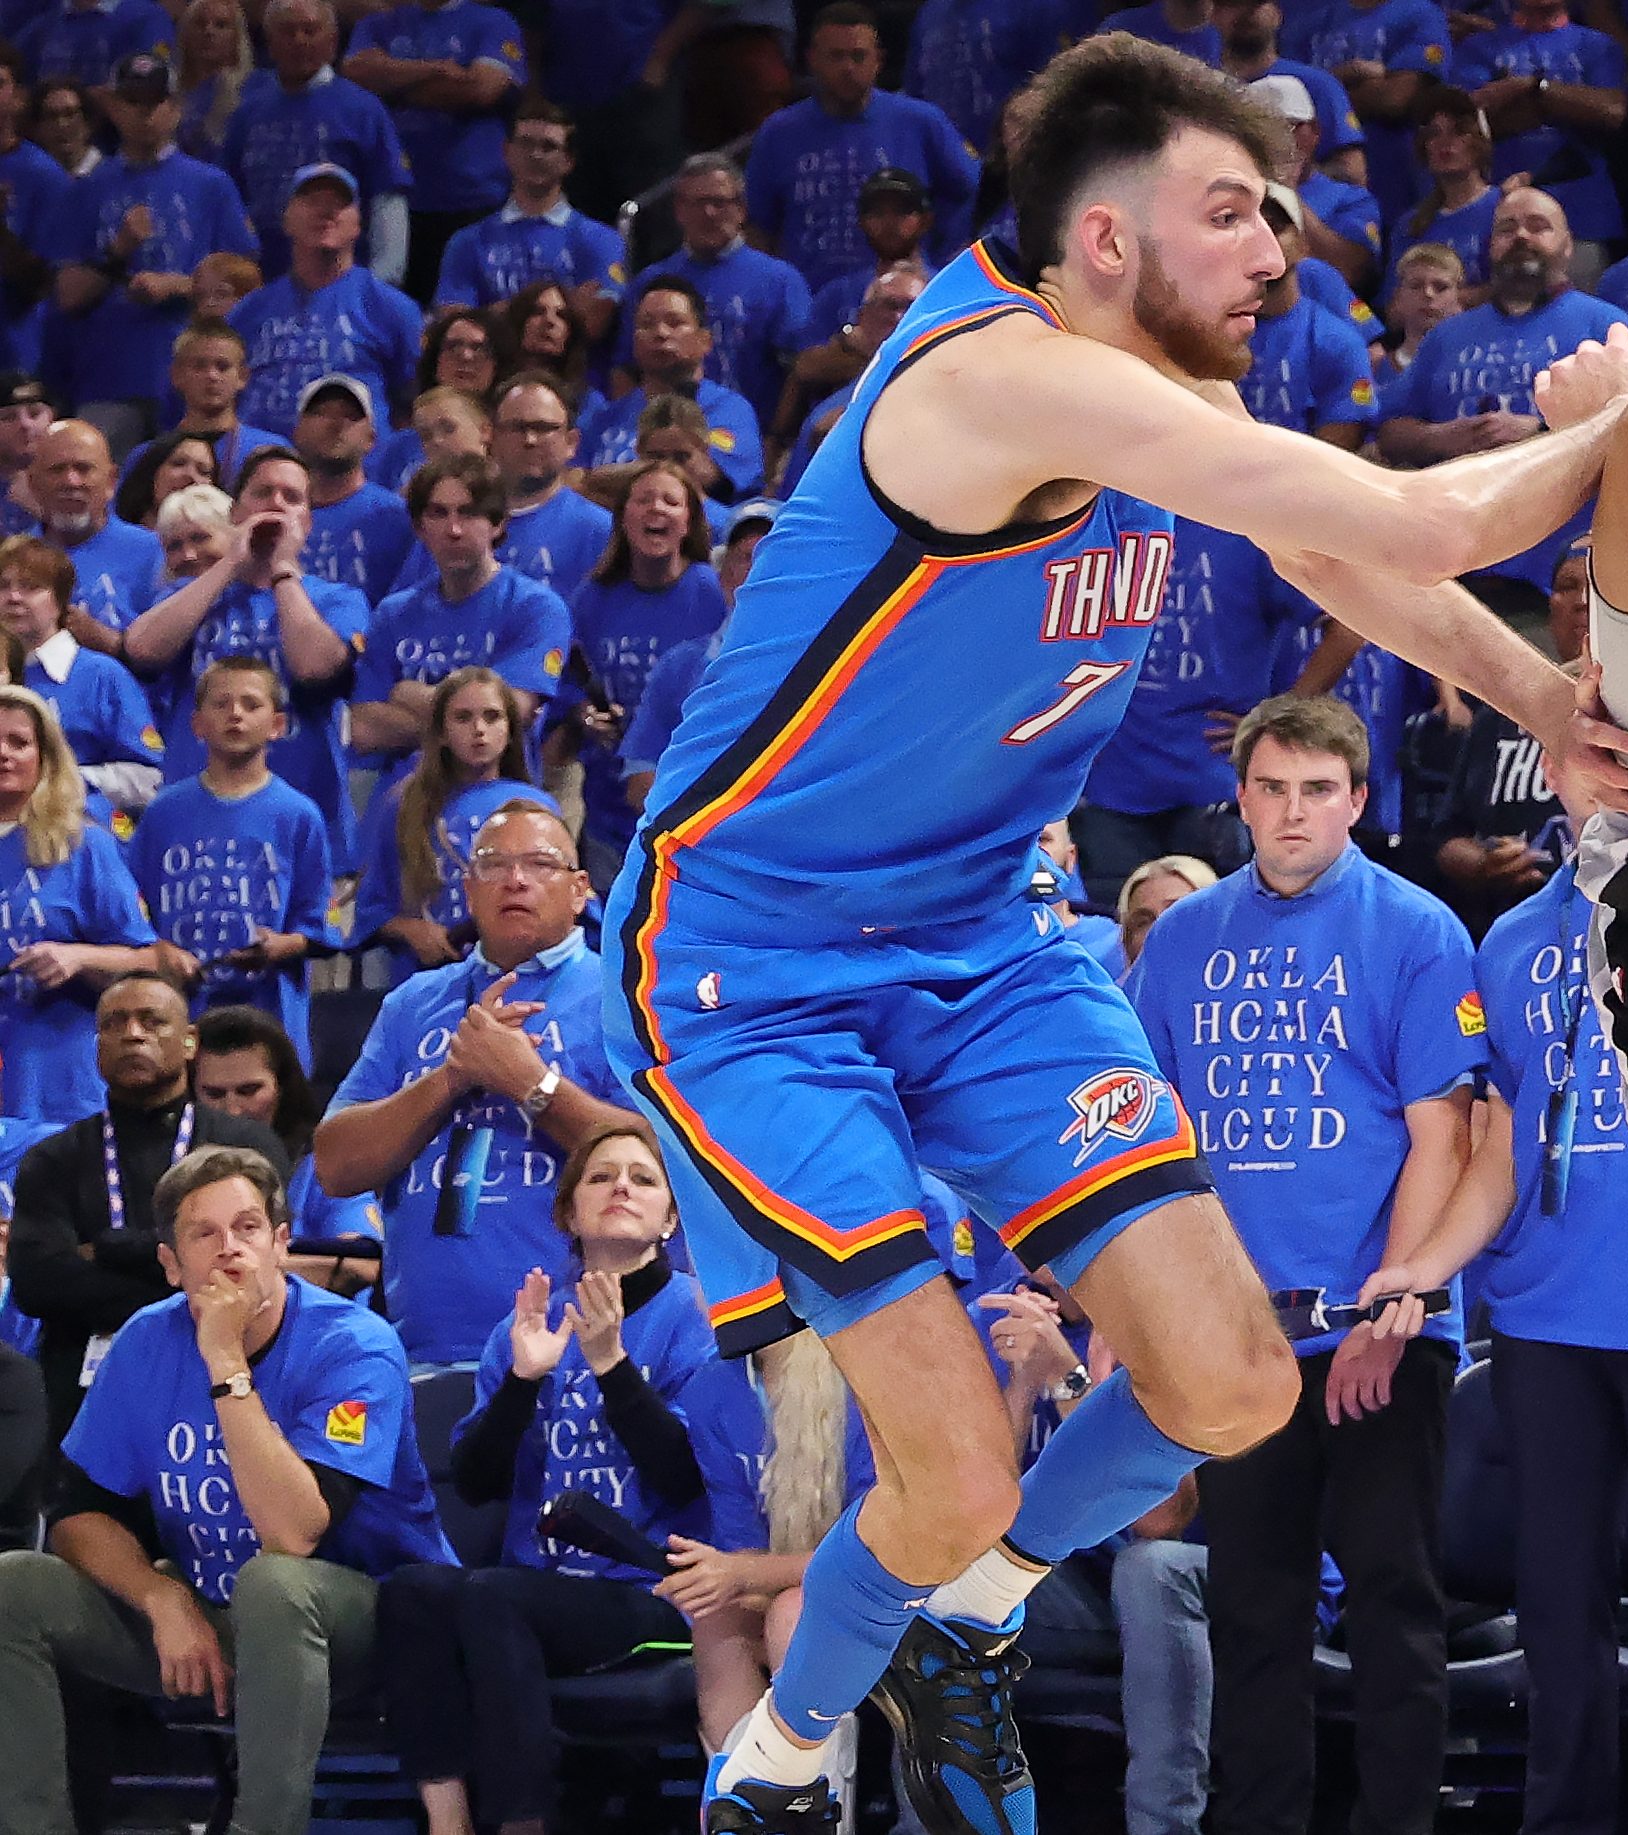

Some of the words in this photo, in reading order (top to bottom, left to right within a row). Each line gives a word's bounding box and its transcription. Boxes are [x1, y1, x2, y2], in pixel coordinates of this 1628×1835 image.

[1001, 661, 1133, 745] 7
[163, 839, 279, 876] OKLA
[1203, 946, 1348, 996] OKLA
[1192, 999, 1349, 1050] HOMA
[1206, 1052, 1333, 1098] CITY
[1086, 1079, 1138, 1140] OKC
[1200, 1106, 1347, 1153] LOUD
